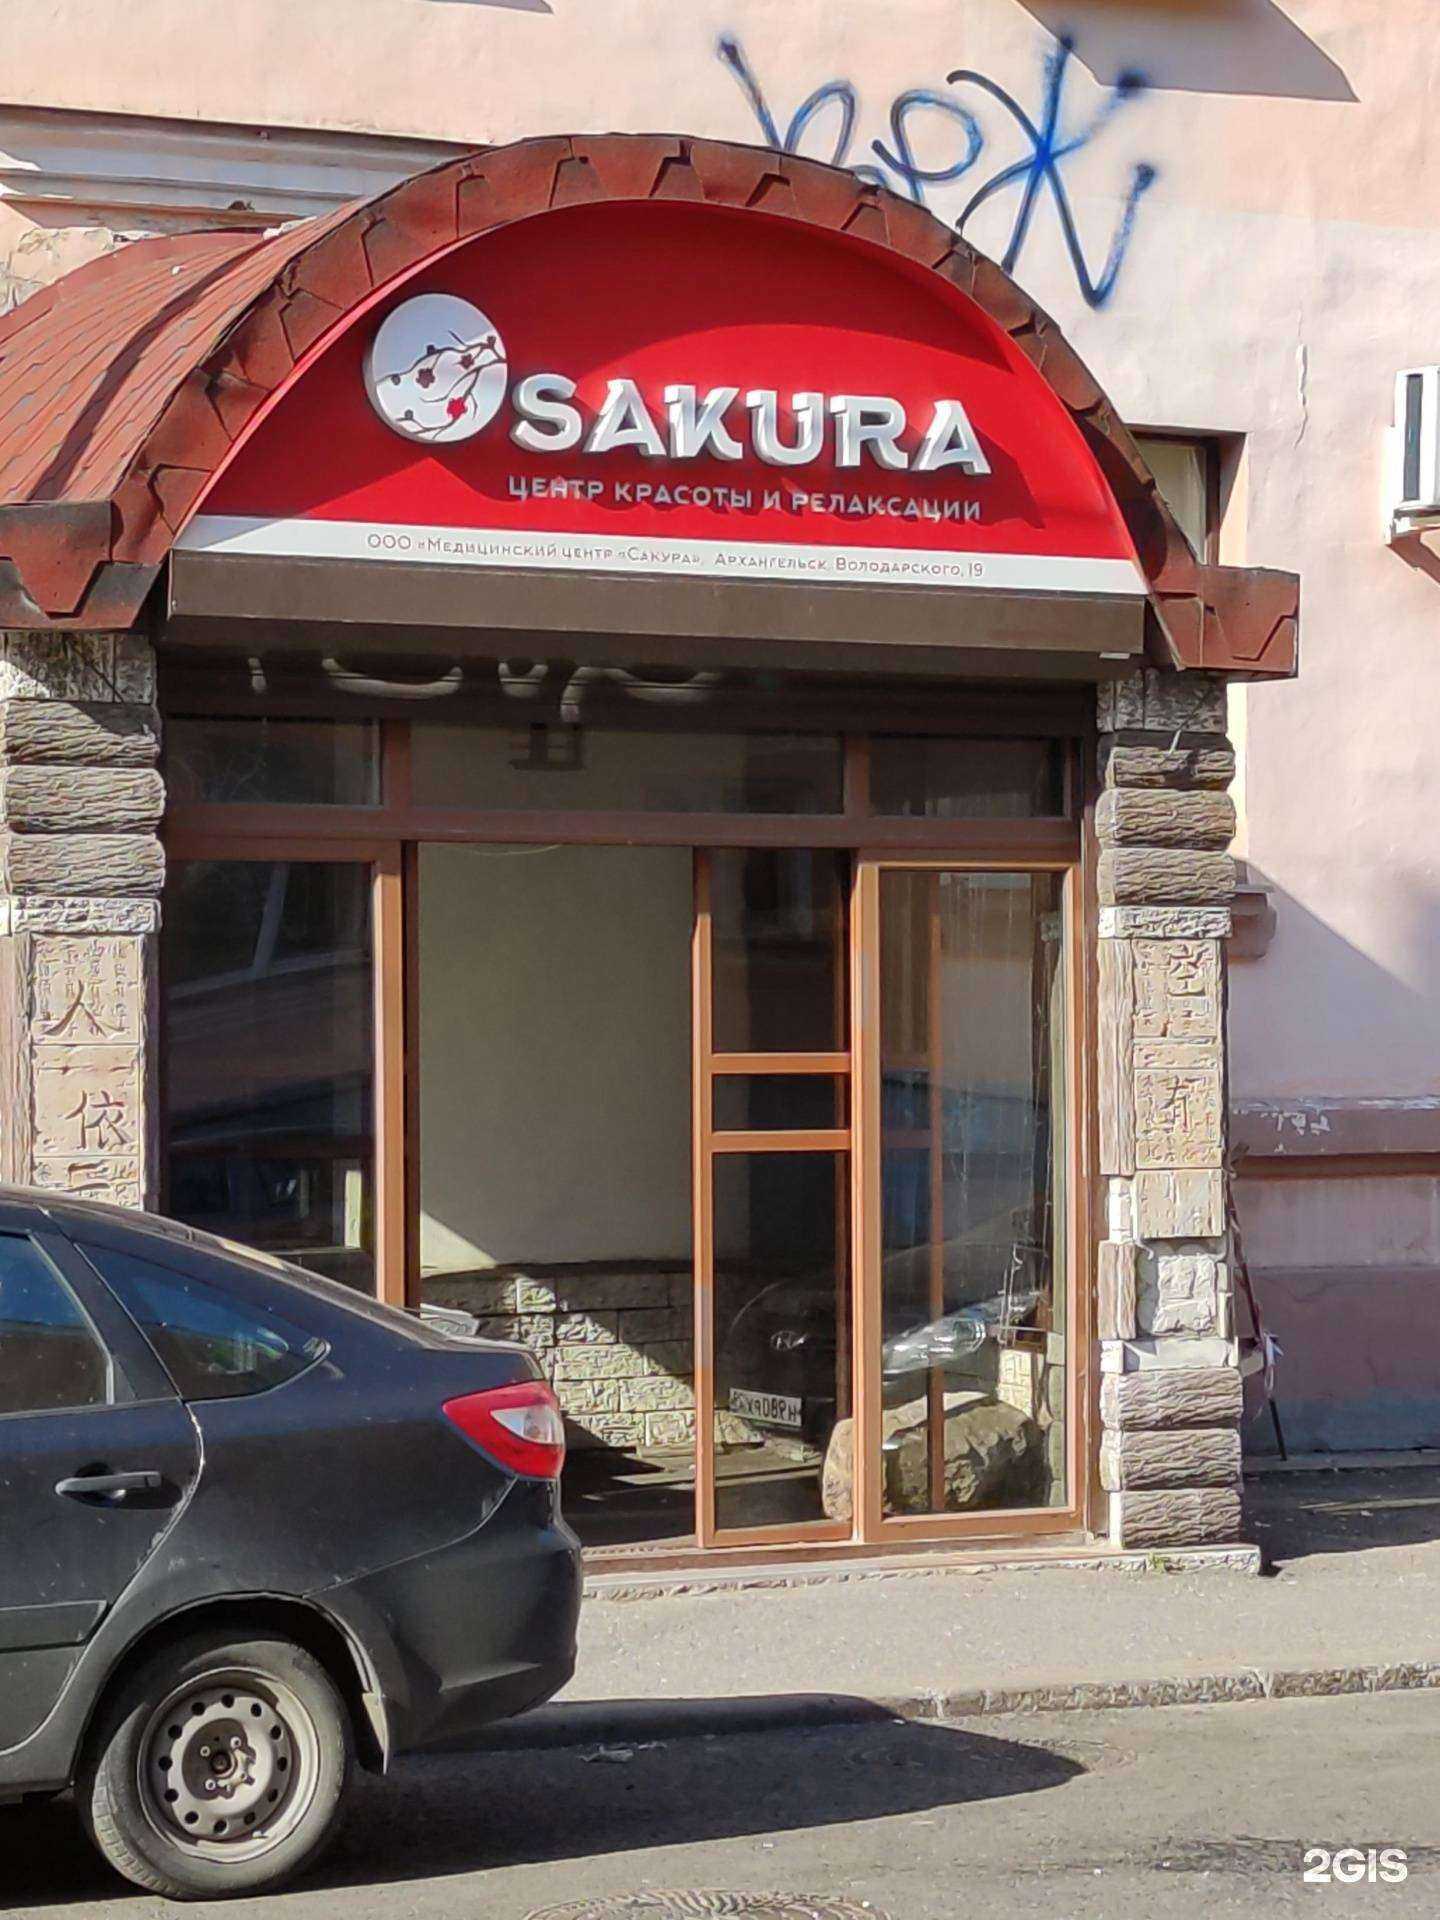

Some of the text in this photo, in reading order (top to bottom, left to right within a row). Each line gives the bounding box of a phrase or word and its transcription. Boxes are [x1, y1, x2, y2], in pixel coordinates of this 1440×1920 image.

[510, 373, 992, 475] SAKURA
[508, 475, 982, 523] ЦЕНТР КРАСОТЫ И РЕЛАКСАЦИИ
[367, 533, 412, 551] ООО
[968, 562, 984, 578] 19
